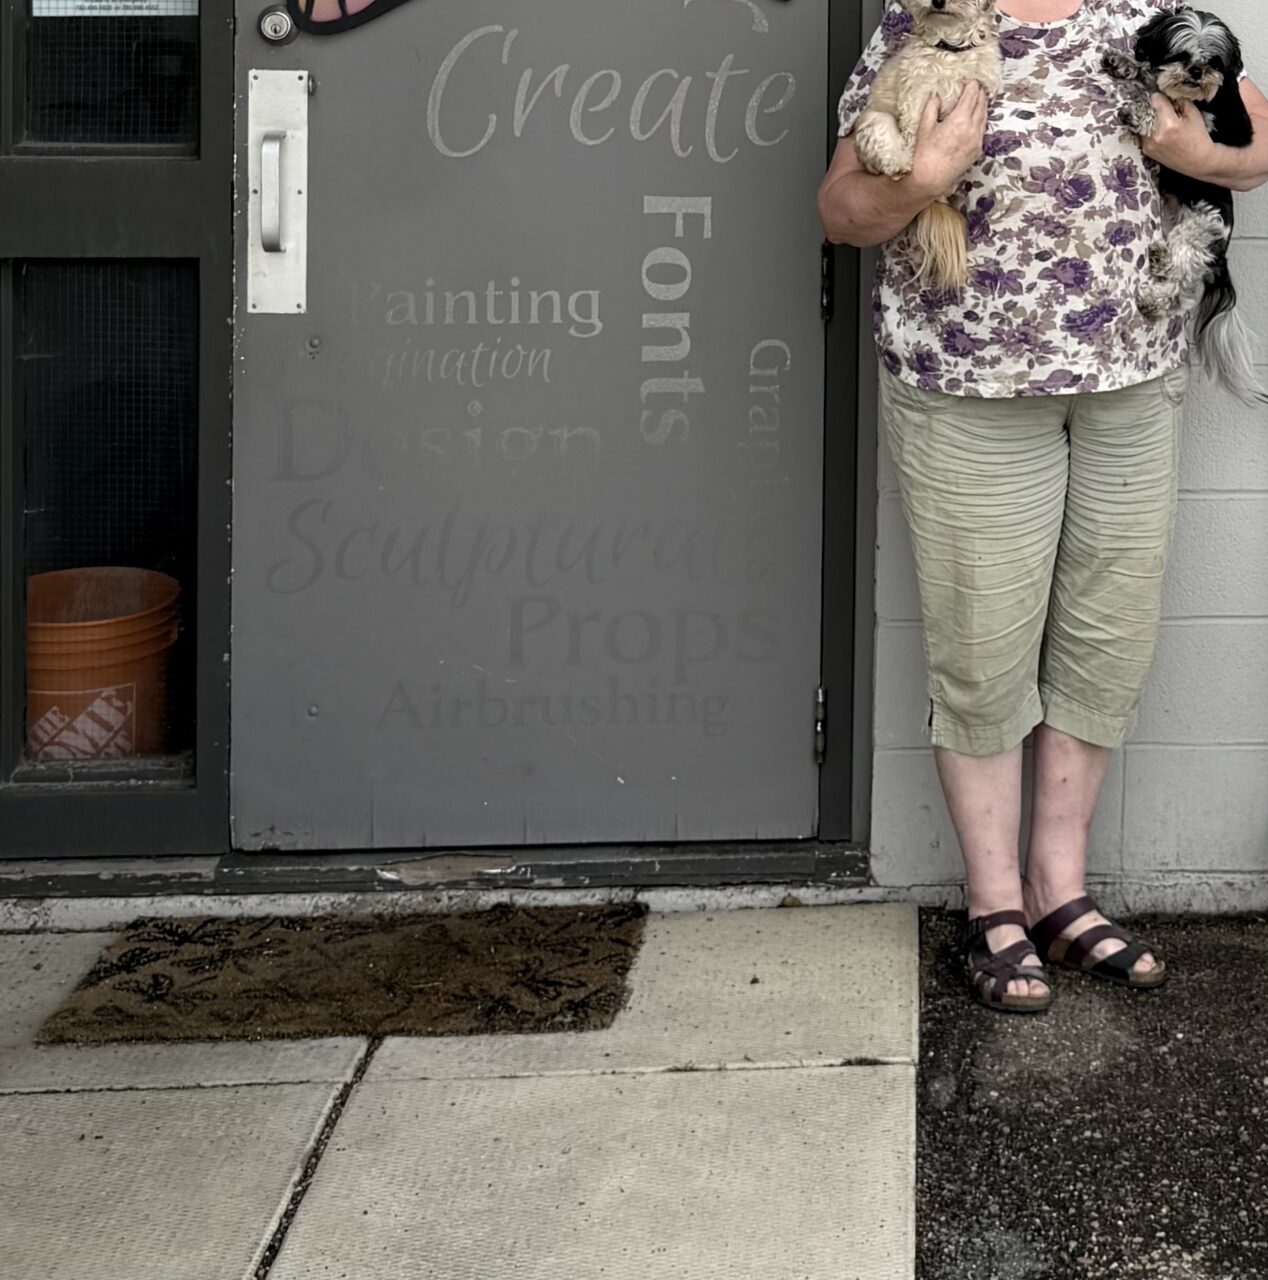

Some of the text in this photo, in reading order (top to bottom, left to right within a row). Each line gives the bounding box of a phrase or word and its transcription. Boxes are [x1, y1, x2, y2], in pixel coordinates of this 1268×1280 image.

[426, 24, 797, 163] Create
[640, 195, 712, 446] Fonts
[504, 595, 780, 686] Props
